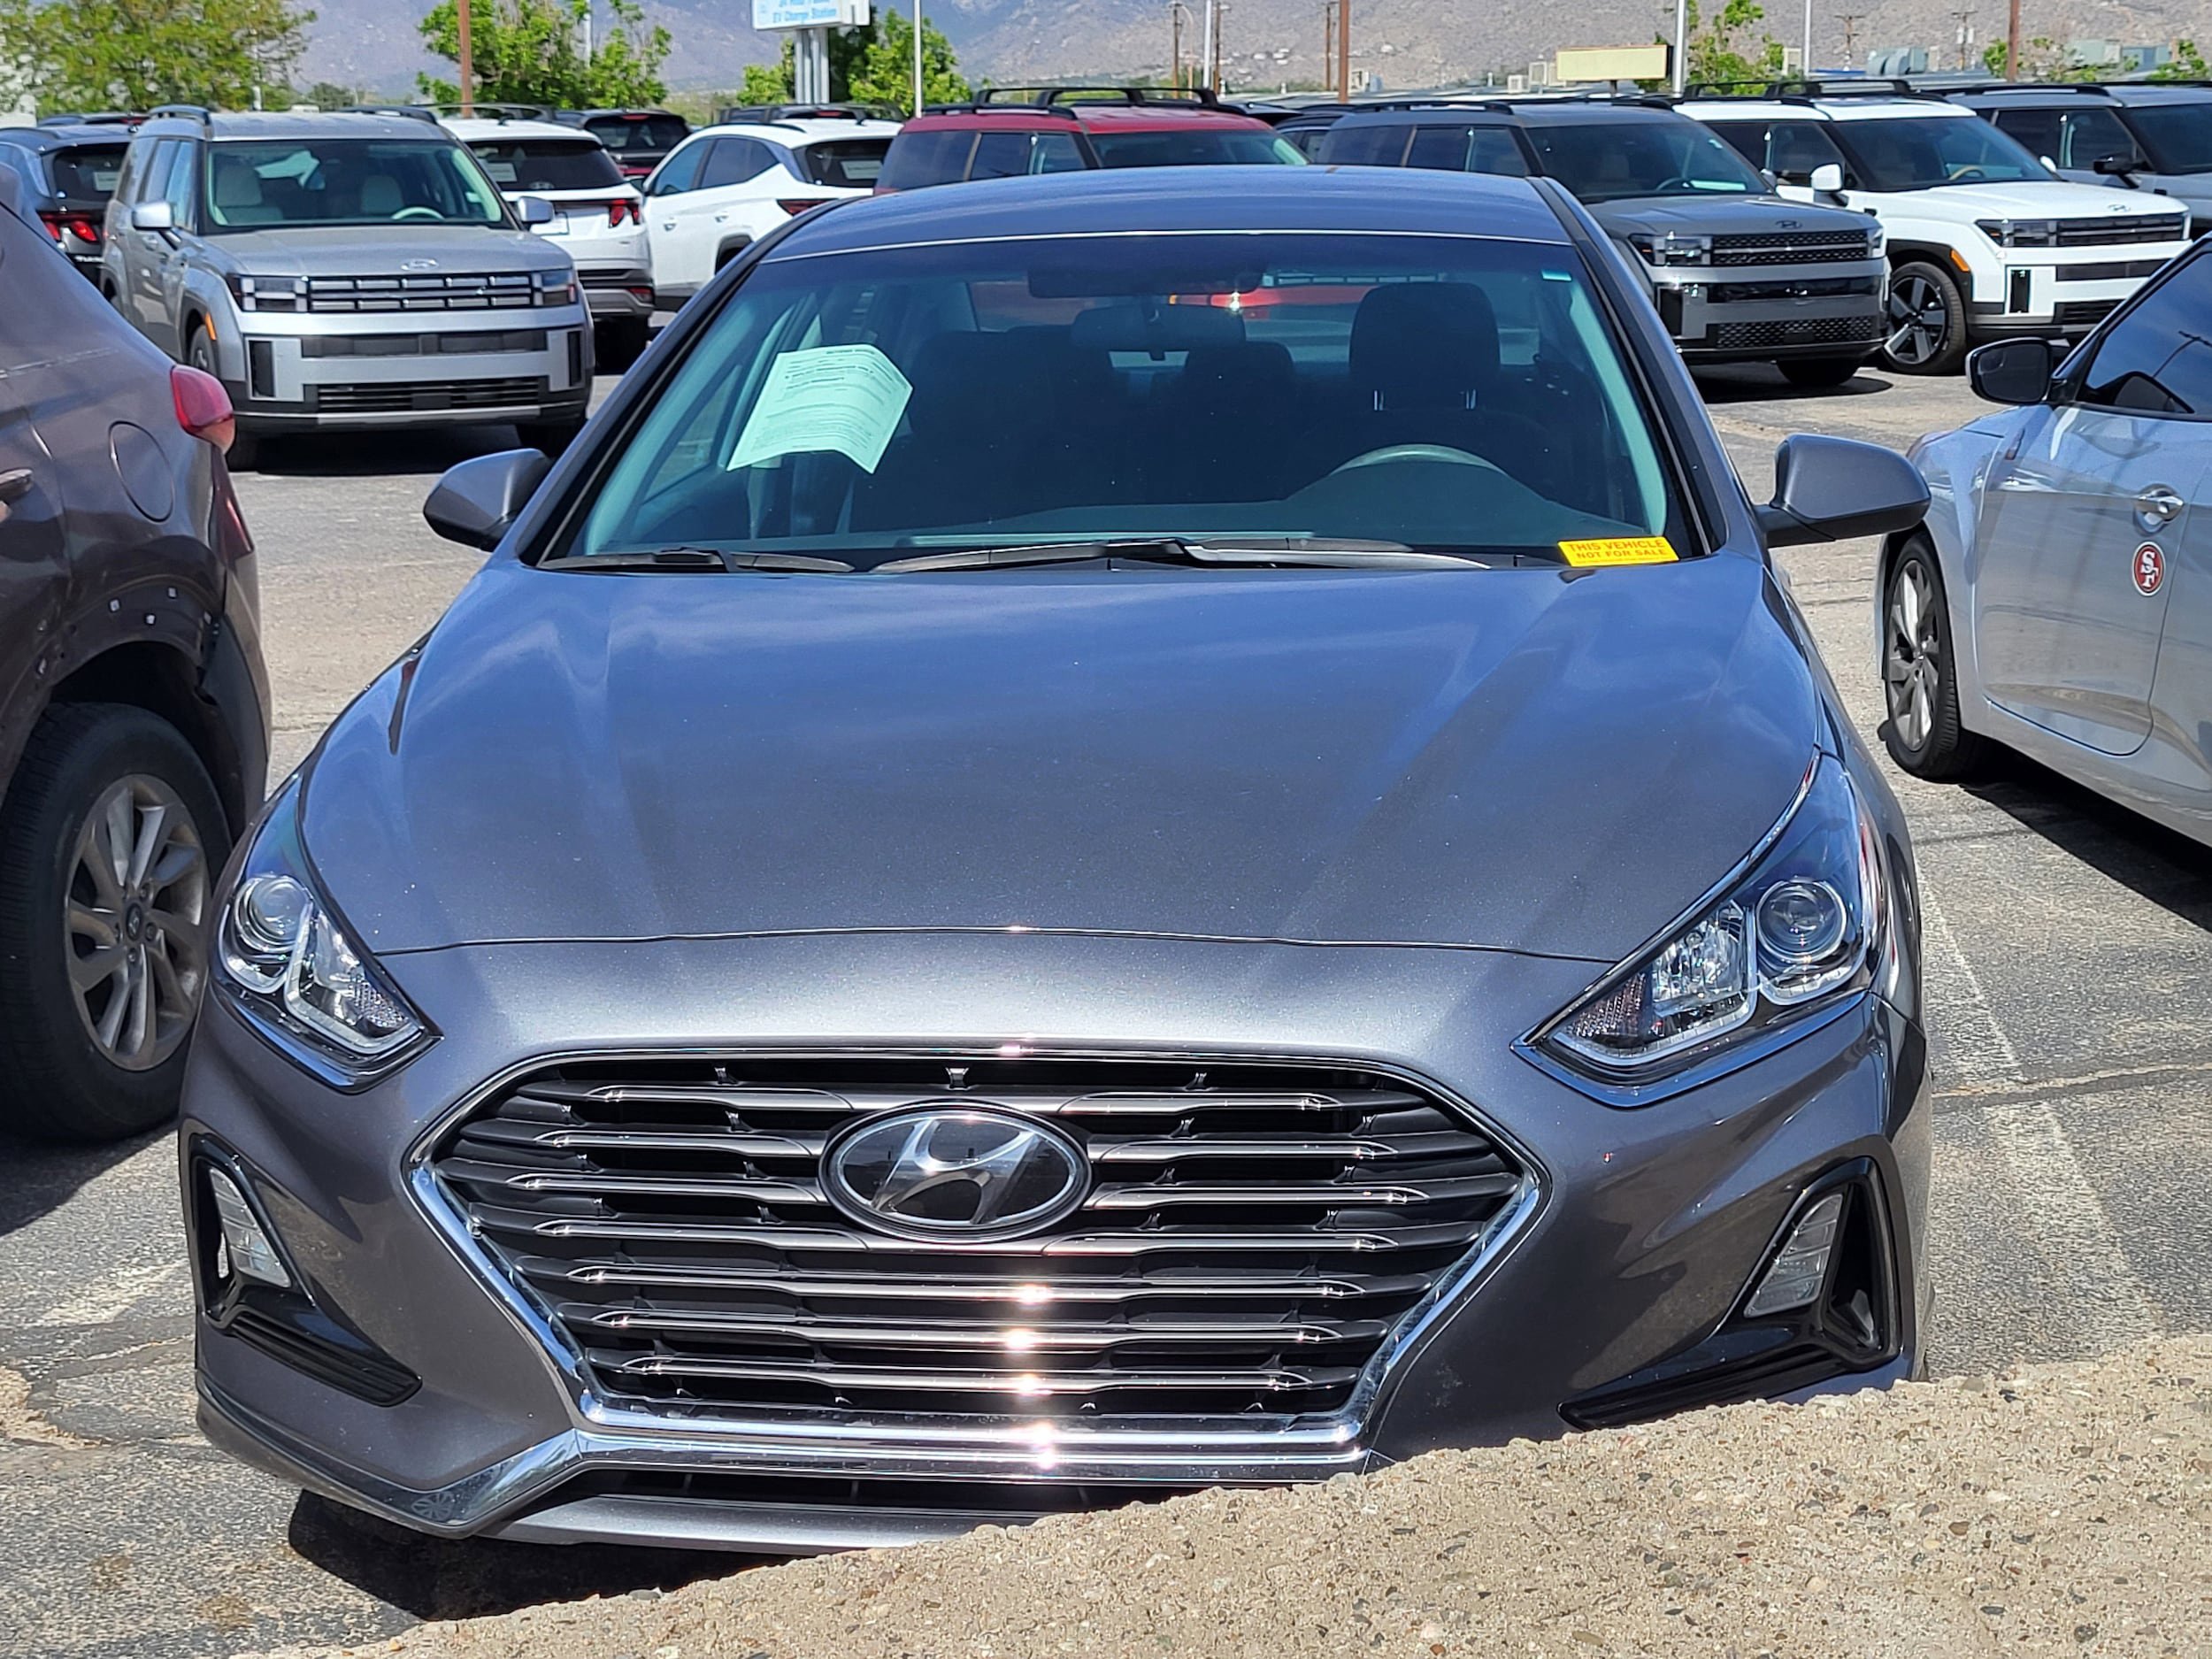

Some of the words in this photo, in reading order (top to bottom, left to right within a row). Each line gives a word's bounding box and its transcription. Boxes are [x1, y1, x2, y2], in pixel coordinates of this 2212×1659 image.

[1569, 541, 1601, 552] THIS
[1604, 539, 1665, 549] VEHICLE
[1605, 549, 1632, 558] FOR
